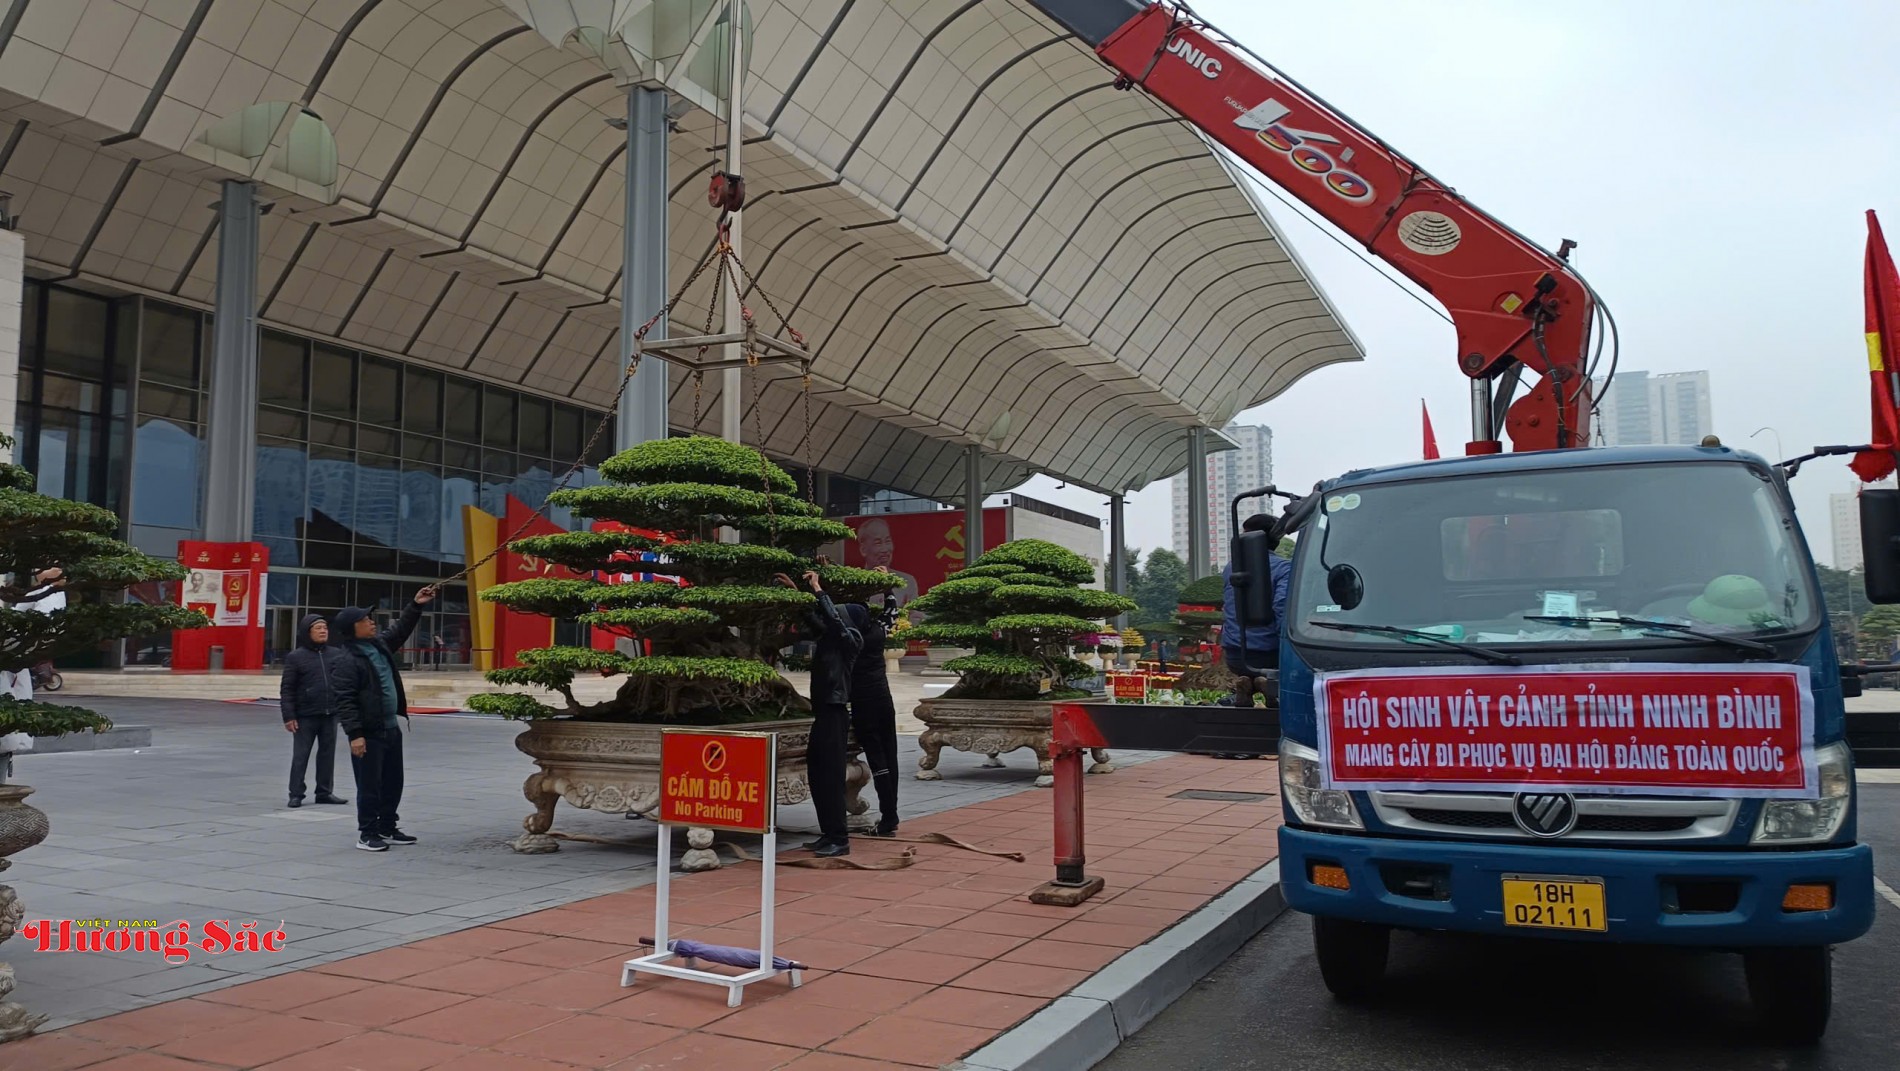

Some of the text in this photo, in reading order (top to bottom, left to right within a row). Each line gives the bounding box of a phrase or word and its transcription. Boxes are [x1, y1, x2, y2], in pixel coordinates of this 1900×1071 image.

[1166, 34, 1222, 79] UNIC
[1343, 683, 1782, 735] HỘI SINH VẬT CẢNH TỈNH NINH BÌNH
[1345, 736, 1784, 774] MANG CÂY ĐI PHỤC VỤ ĐẠI HỘI ĐẢNG TOÀN QUỐC
[667, 771, 758, 803] CẤM ĐỖ XE
[675, 800, 743, 822] No Parking
[1534, 884, 1574, 904] 18H
[1515, 904, 1592, 927] 021.11
